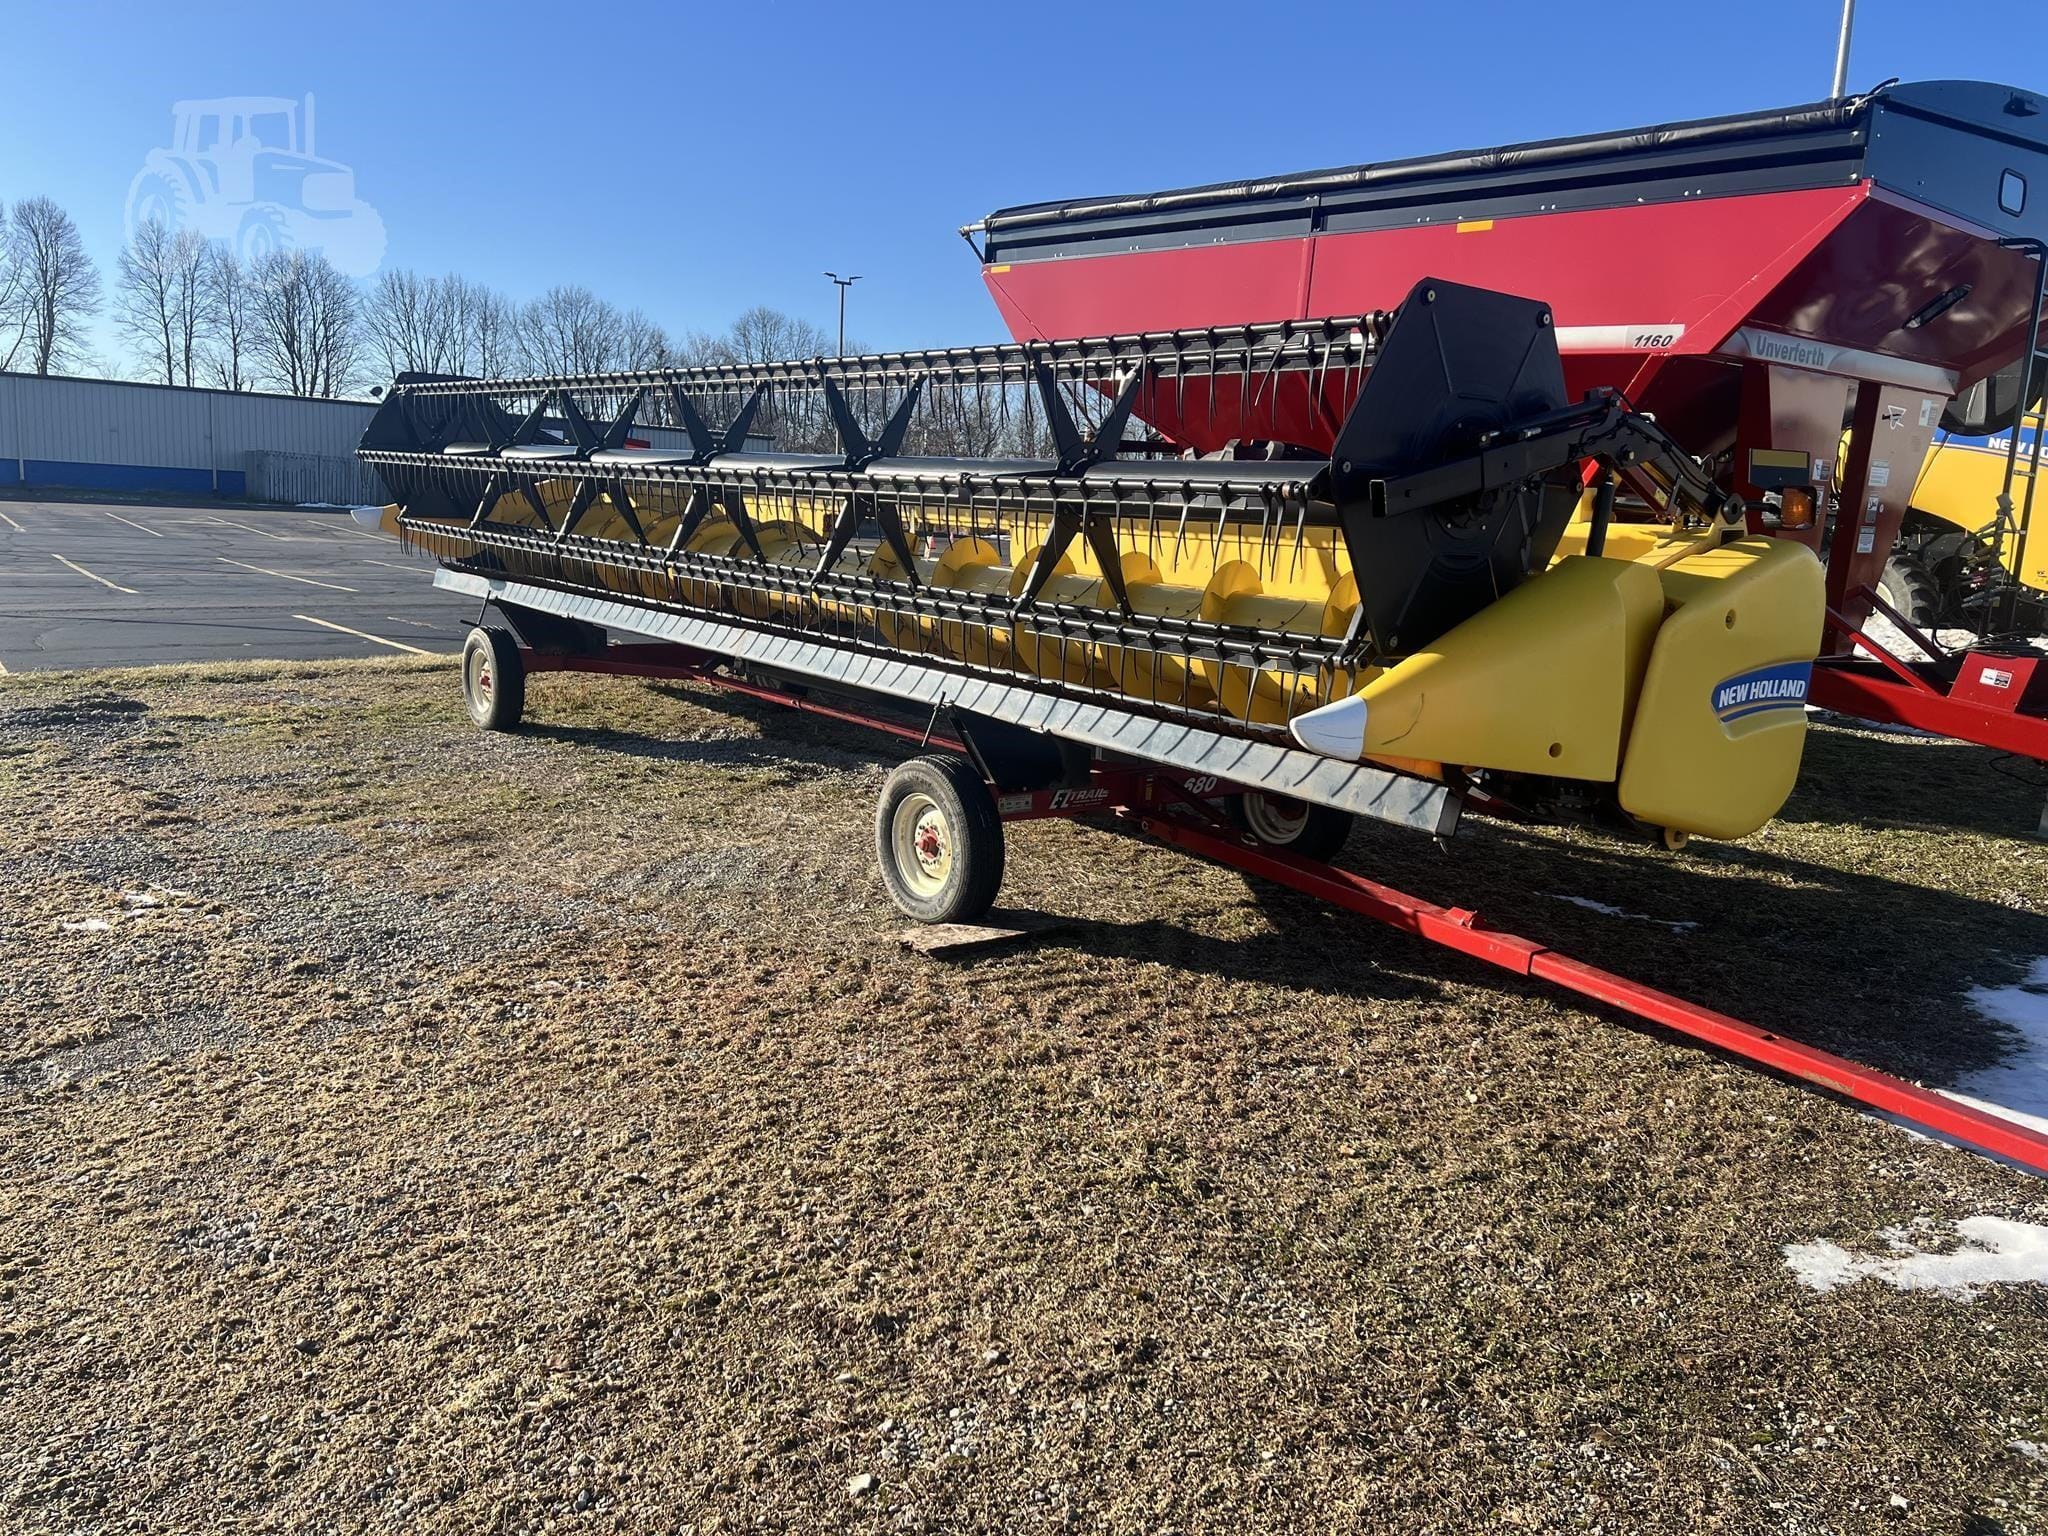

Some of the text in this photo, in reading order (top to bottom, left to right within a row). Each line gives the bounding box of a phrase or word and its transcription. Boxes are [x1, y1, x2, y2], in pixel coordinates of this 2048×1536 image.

[1633, 334, 1673, 348] 1160
[1756, 335, 1825, 367] Unverferth
[1719, 679, 1806, 708] NEW HOLLAND
